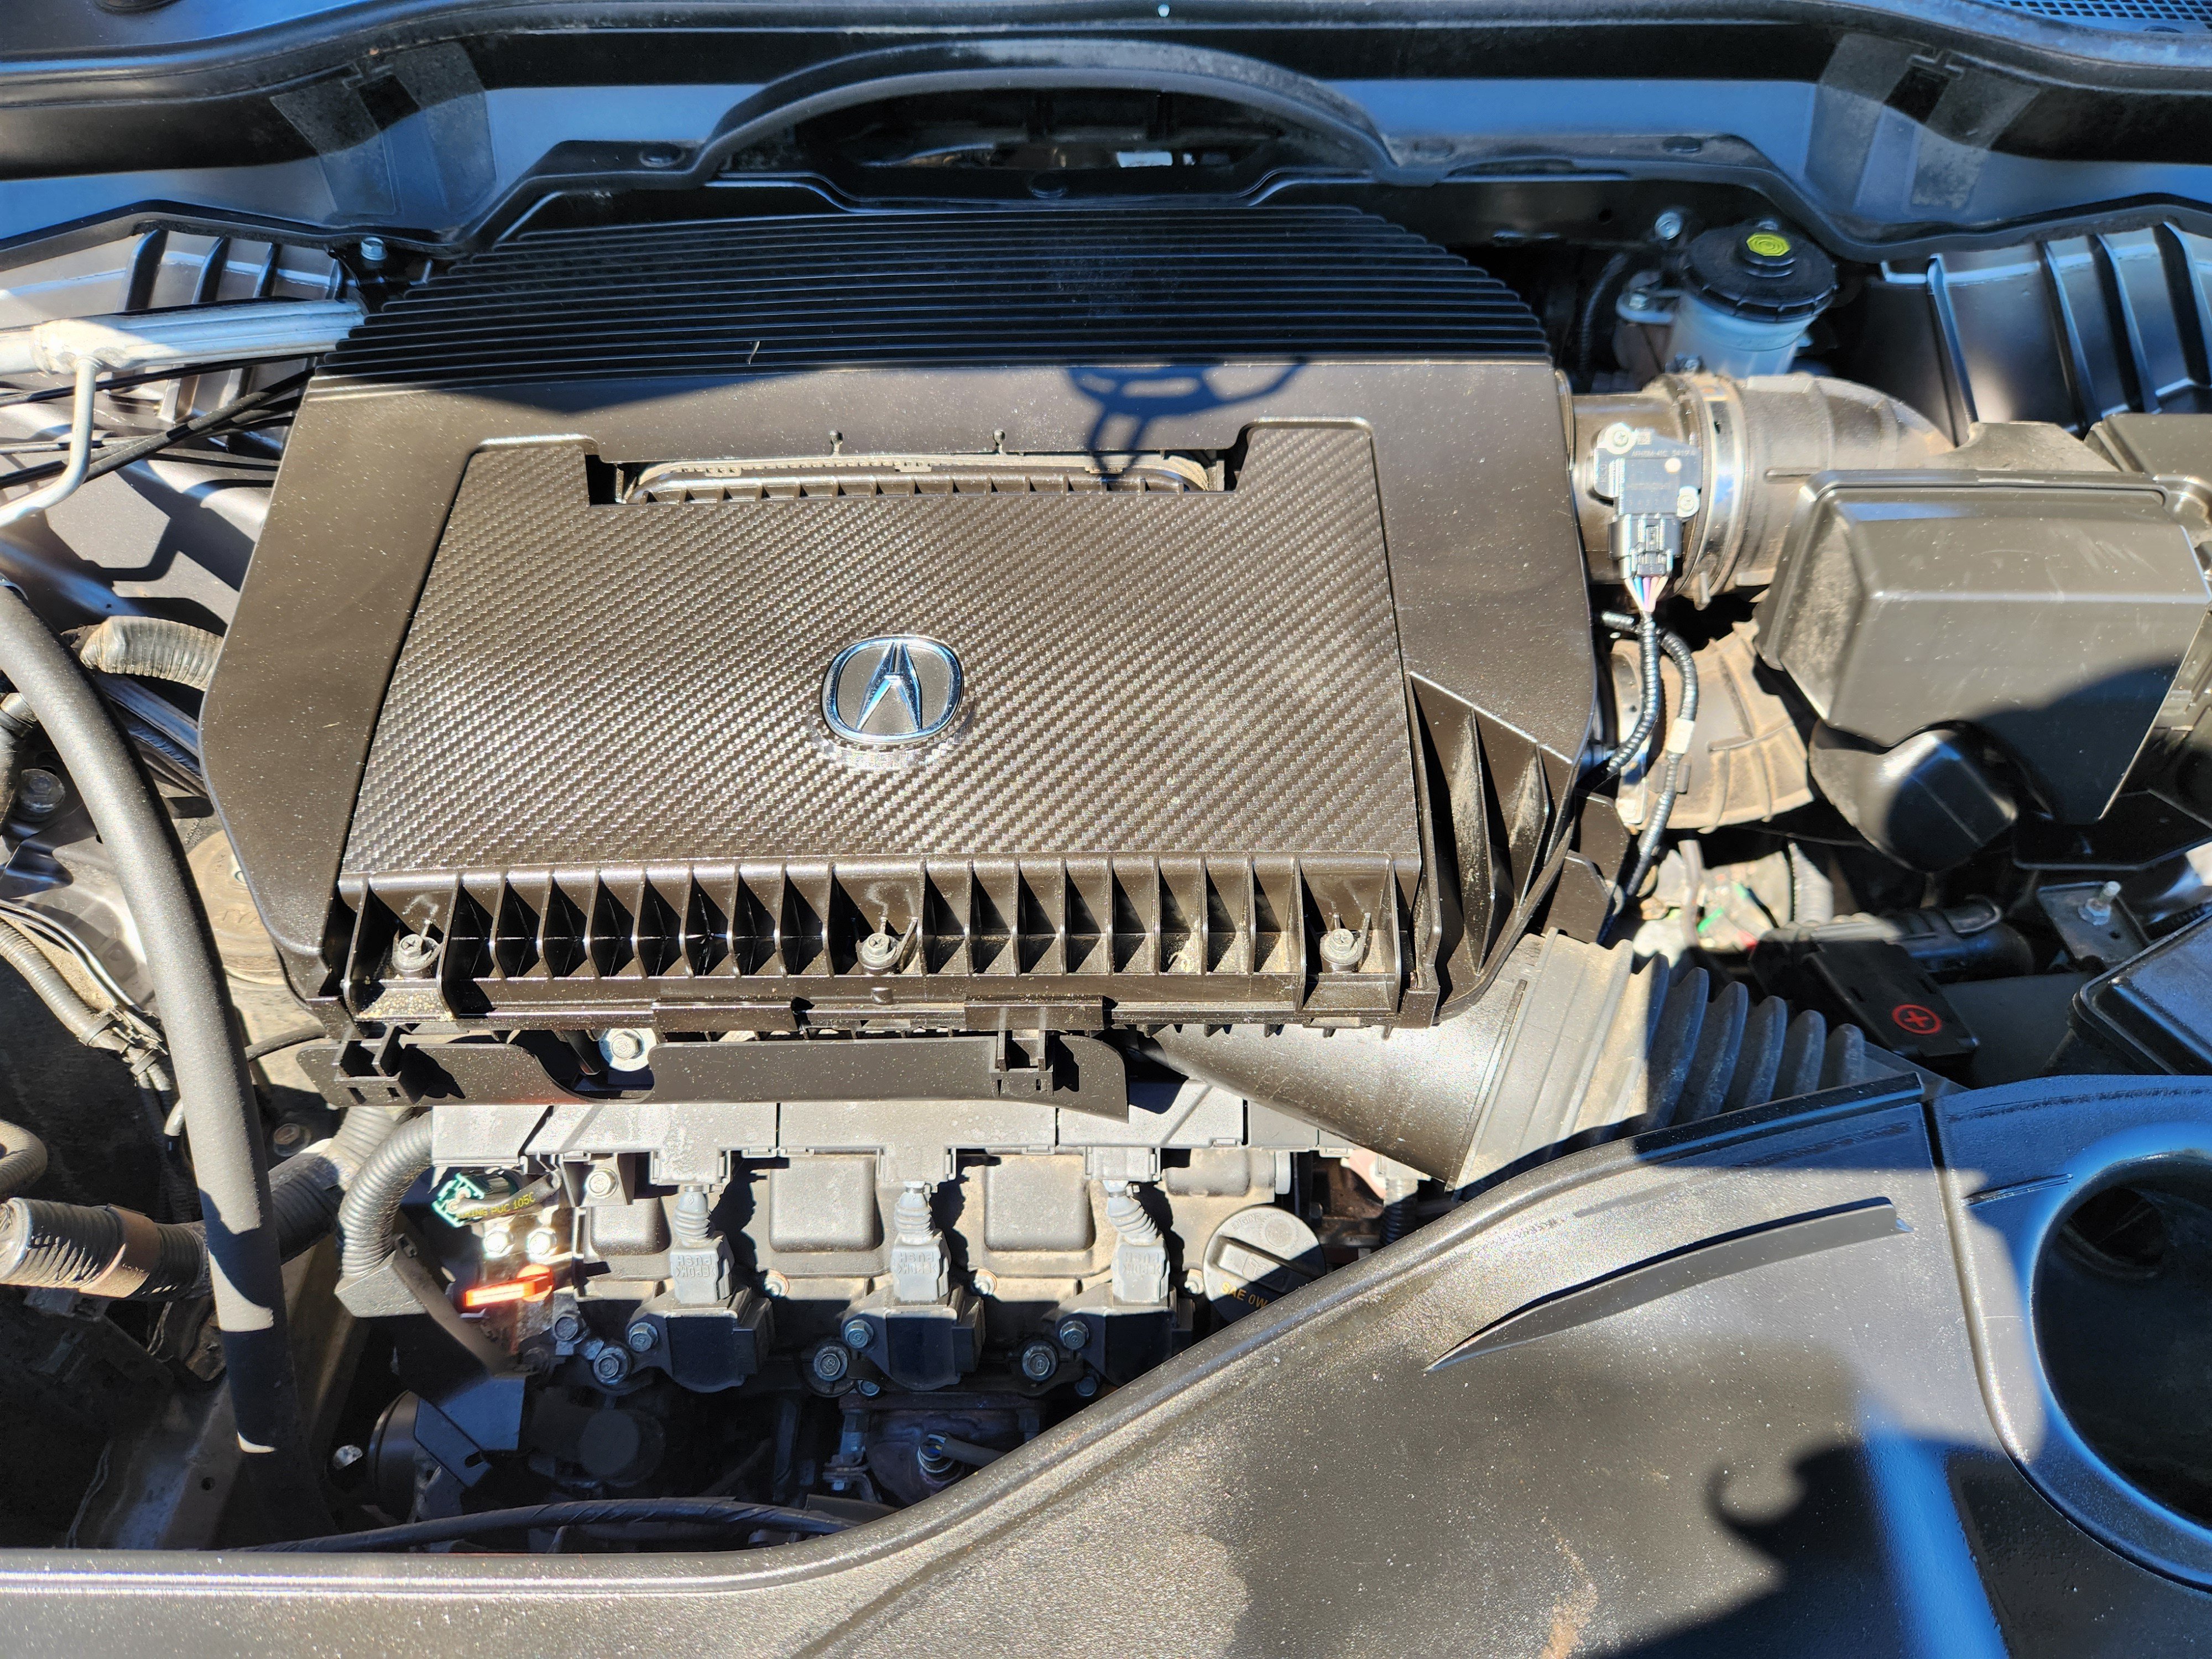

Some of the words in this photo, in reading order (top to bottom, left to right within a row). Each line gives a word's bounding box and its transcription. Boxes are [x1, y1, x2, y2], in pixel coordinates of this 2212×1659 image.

[491, 1203, 510, 1215] PVC
[513, 1191, 536, 1210] 105C
[677, 1255, 712, 1266] PUSH
[900, 1251, 934, 1262] PUSH
[1125, 1252, 1159, 1263] PUSH
[1220, 1281, 1246, 1301] SAE
